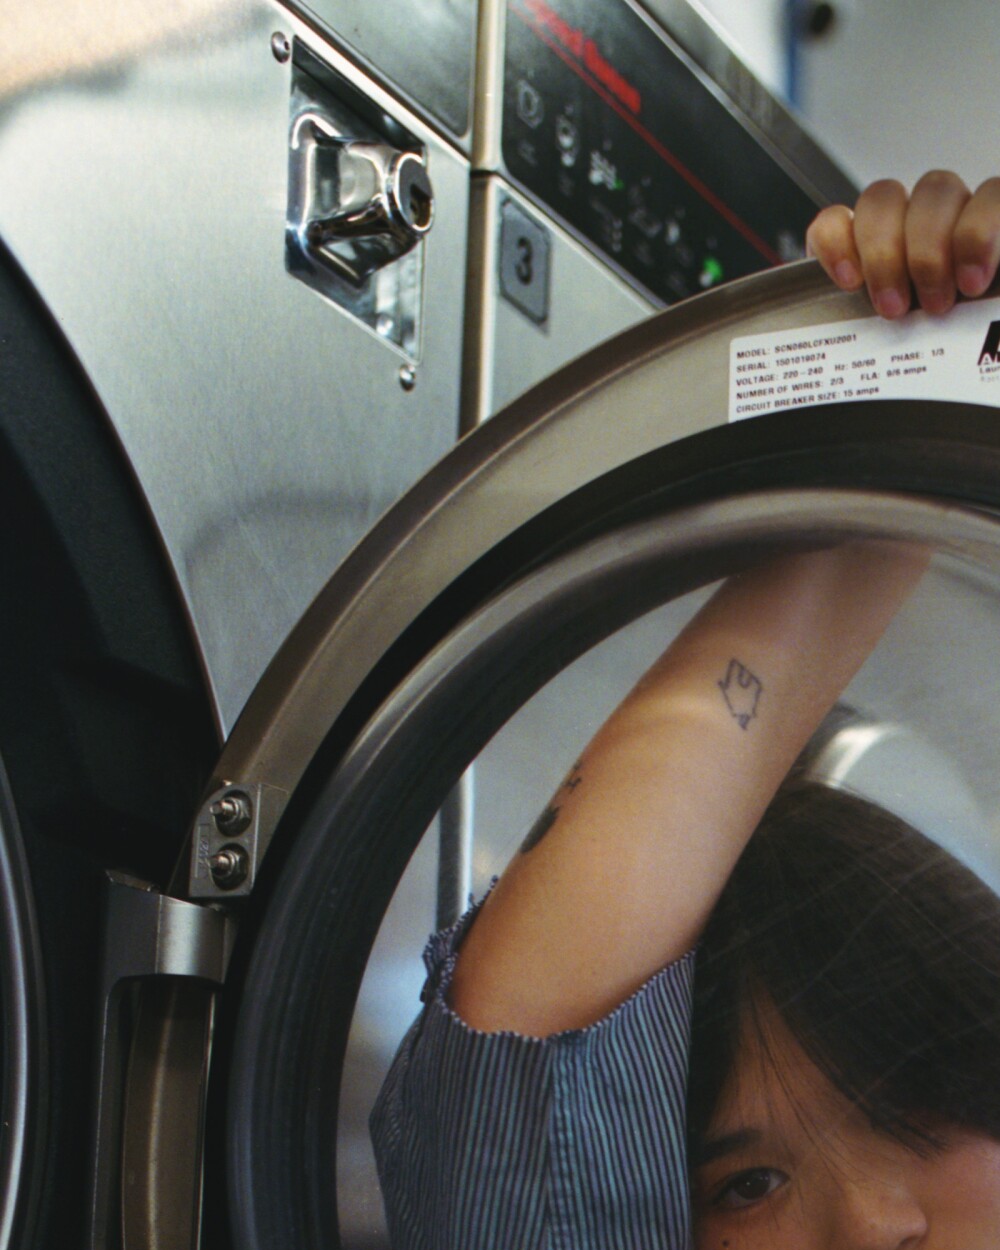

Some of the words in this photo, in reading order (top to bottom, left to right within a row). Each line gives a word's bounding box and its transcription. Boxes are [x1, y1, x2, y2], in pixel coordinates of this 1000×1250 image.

[515, 237, 533, 286] 3
[736, 347, 770, 359] MODEL:
[736, 361, 770, 373] SERIAL:
[736, 374, 779, 386] VOLTAGE:
[835, 363, 849, 371] Hz:
[851, 358, 876, 369] 50/60
[891, 352, 924, 362] PHASE:
[931, 348, 945, 357] 1/3
[736, 387, 775, 400] NUMBER
[776, 385, 788, 394] OF
[792, 380, 824, 391] WIRES:
[830, 377, 844, 386] 2/3
[860, 371, 880, 381] FLA:
[903, 365, 927, 375] amps
[736, 401, 771, 413] CIRCUIT
[774, 394, 816, 408] BREAKER
[817, 391, 840, 401] SIZE:
[843, 389, 853, 398] 15
[856, 386, 879, 396] amps
